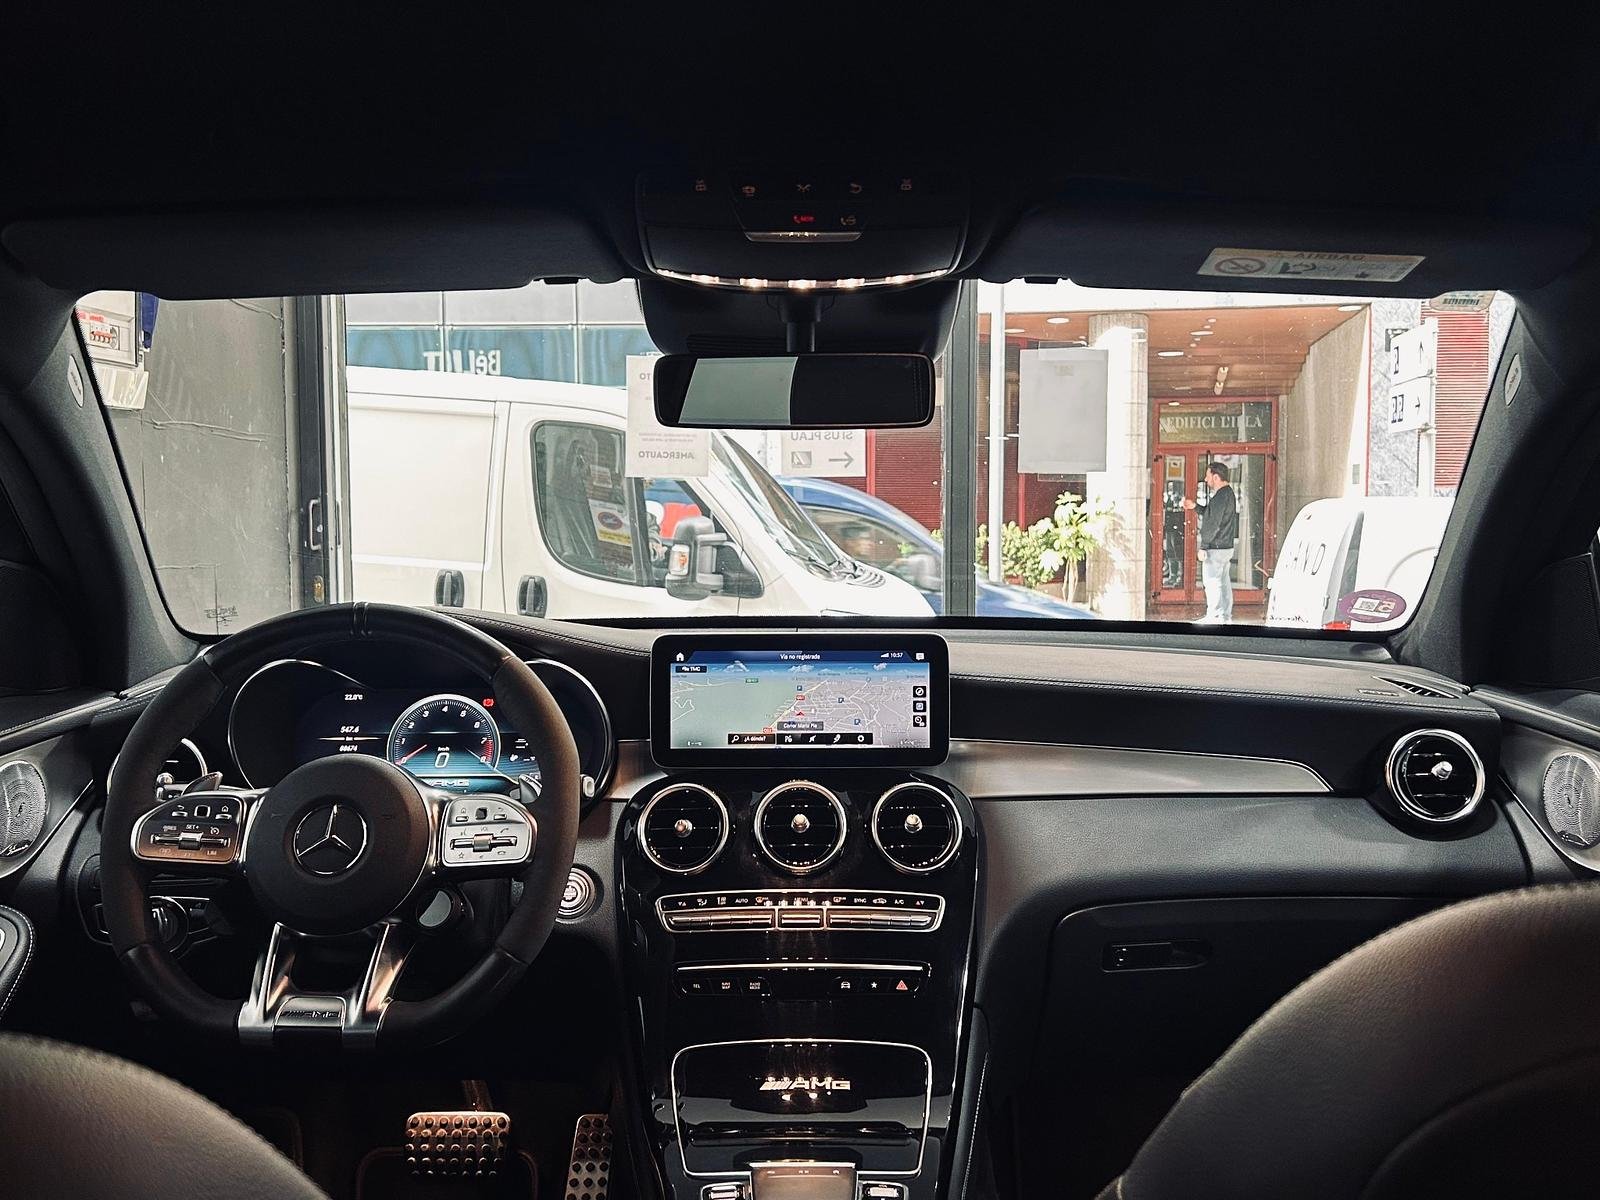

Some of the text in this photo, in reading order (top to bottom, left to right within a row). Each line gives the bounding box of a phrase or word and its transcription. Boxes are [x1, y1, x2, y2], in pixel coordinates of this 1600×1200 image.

[441, 705, 449, 713] 4
[422, 710, 430, 718] 3
[460, 710, 467, 718] 5
[400, 737, 406, 745] 1
[434, 752, 450, 768] 0
[788, 1080, 850, 1090] AMG
